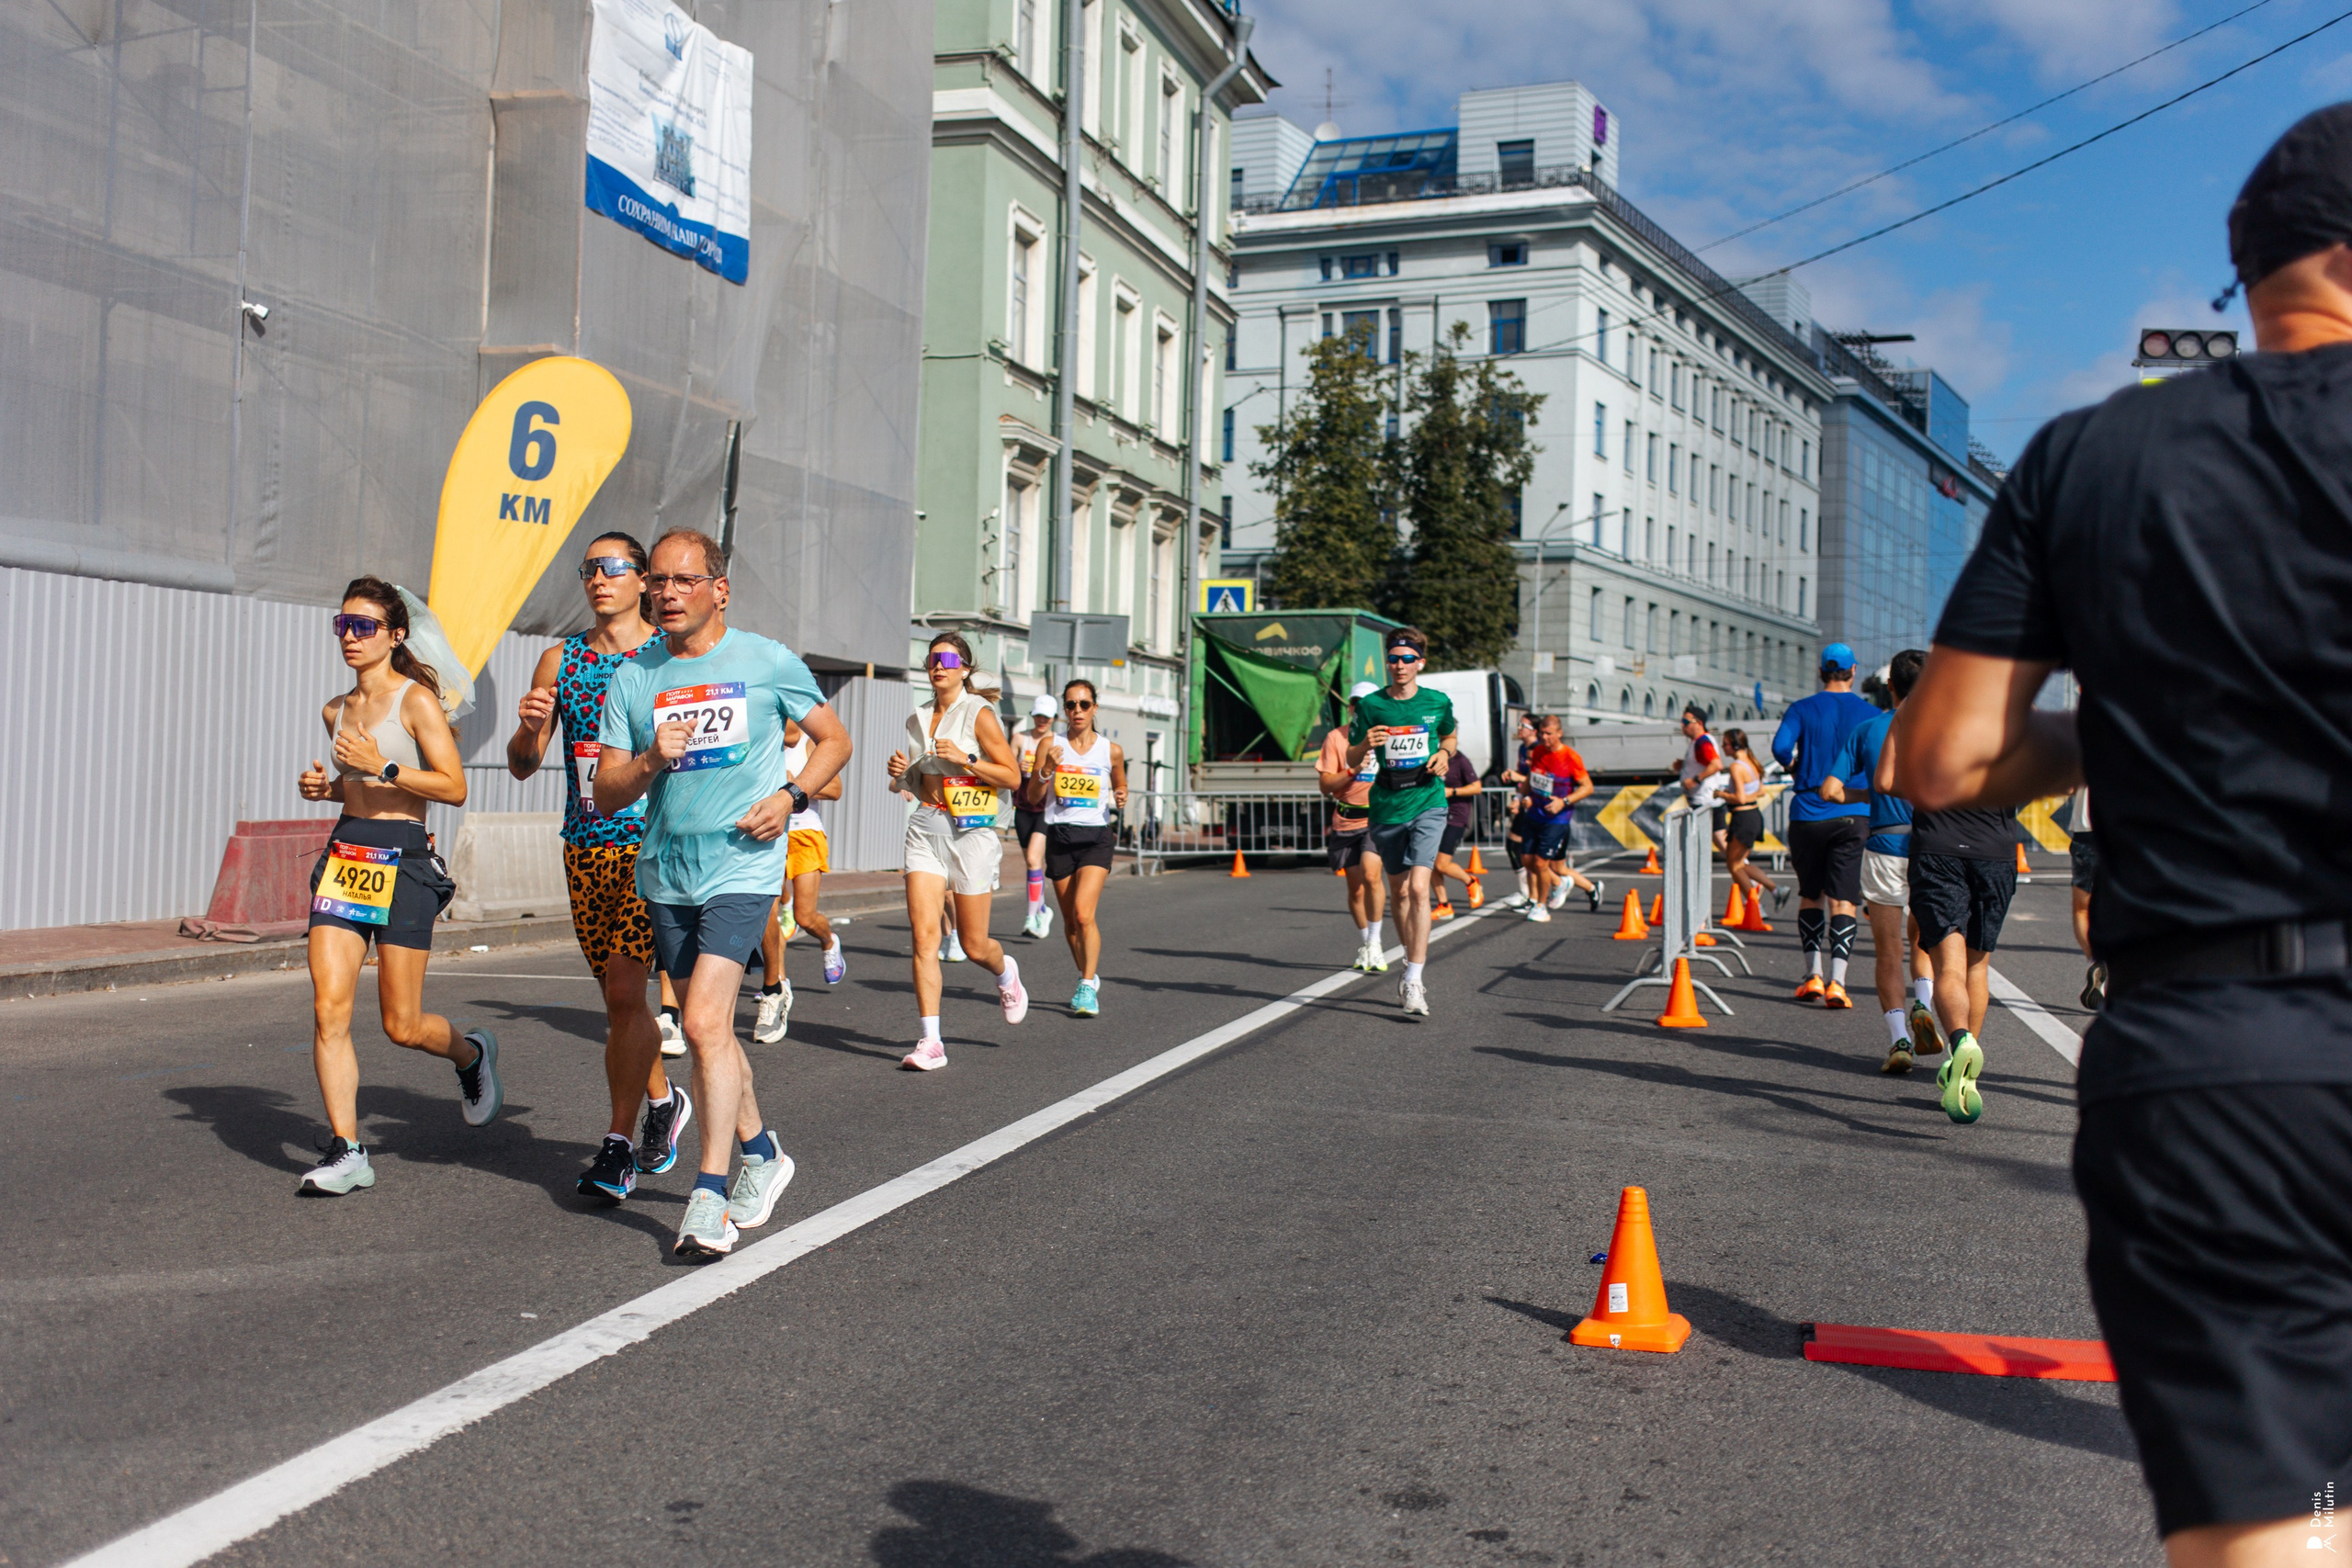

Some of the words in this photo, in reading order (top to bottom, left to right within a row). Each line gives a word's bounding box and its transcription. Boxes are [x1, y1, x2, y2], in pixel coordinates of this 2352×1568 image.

[617, 194, 672, 237] СОХРАНИМ
[508, 400, 560, 481] 6
[666, 694, 694, 702] МАРАФОН
[705, 688, 718, 696] 21,1
[687, 734, 719, 746] СЕРГЕЙ
[1390, 737, 1423, 751] 4476
[1060, 776, 1094, 791] 3292
[587, 799, 594, 812] D
[952, 791, 990, 807] 4767
[366, 852, 377, 860] 21,1
[333, 865, 385, 893] 4920
[342, 890, 372, 901] НАТАЛЬЯ
[320, 898, 332, 911] D
